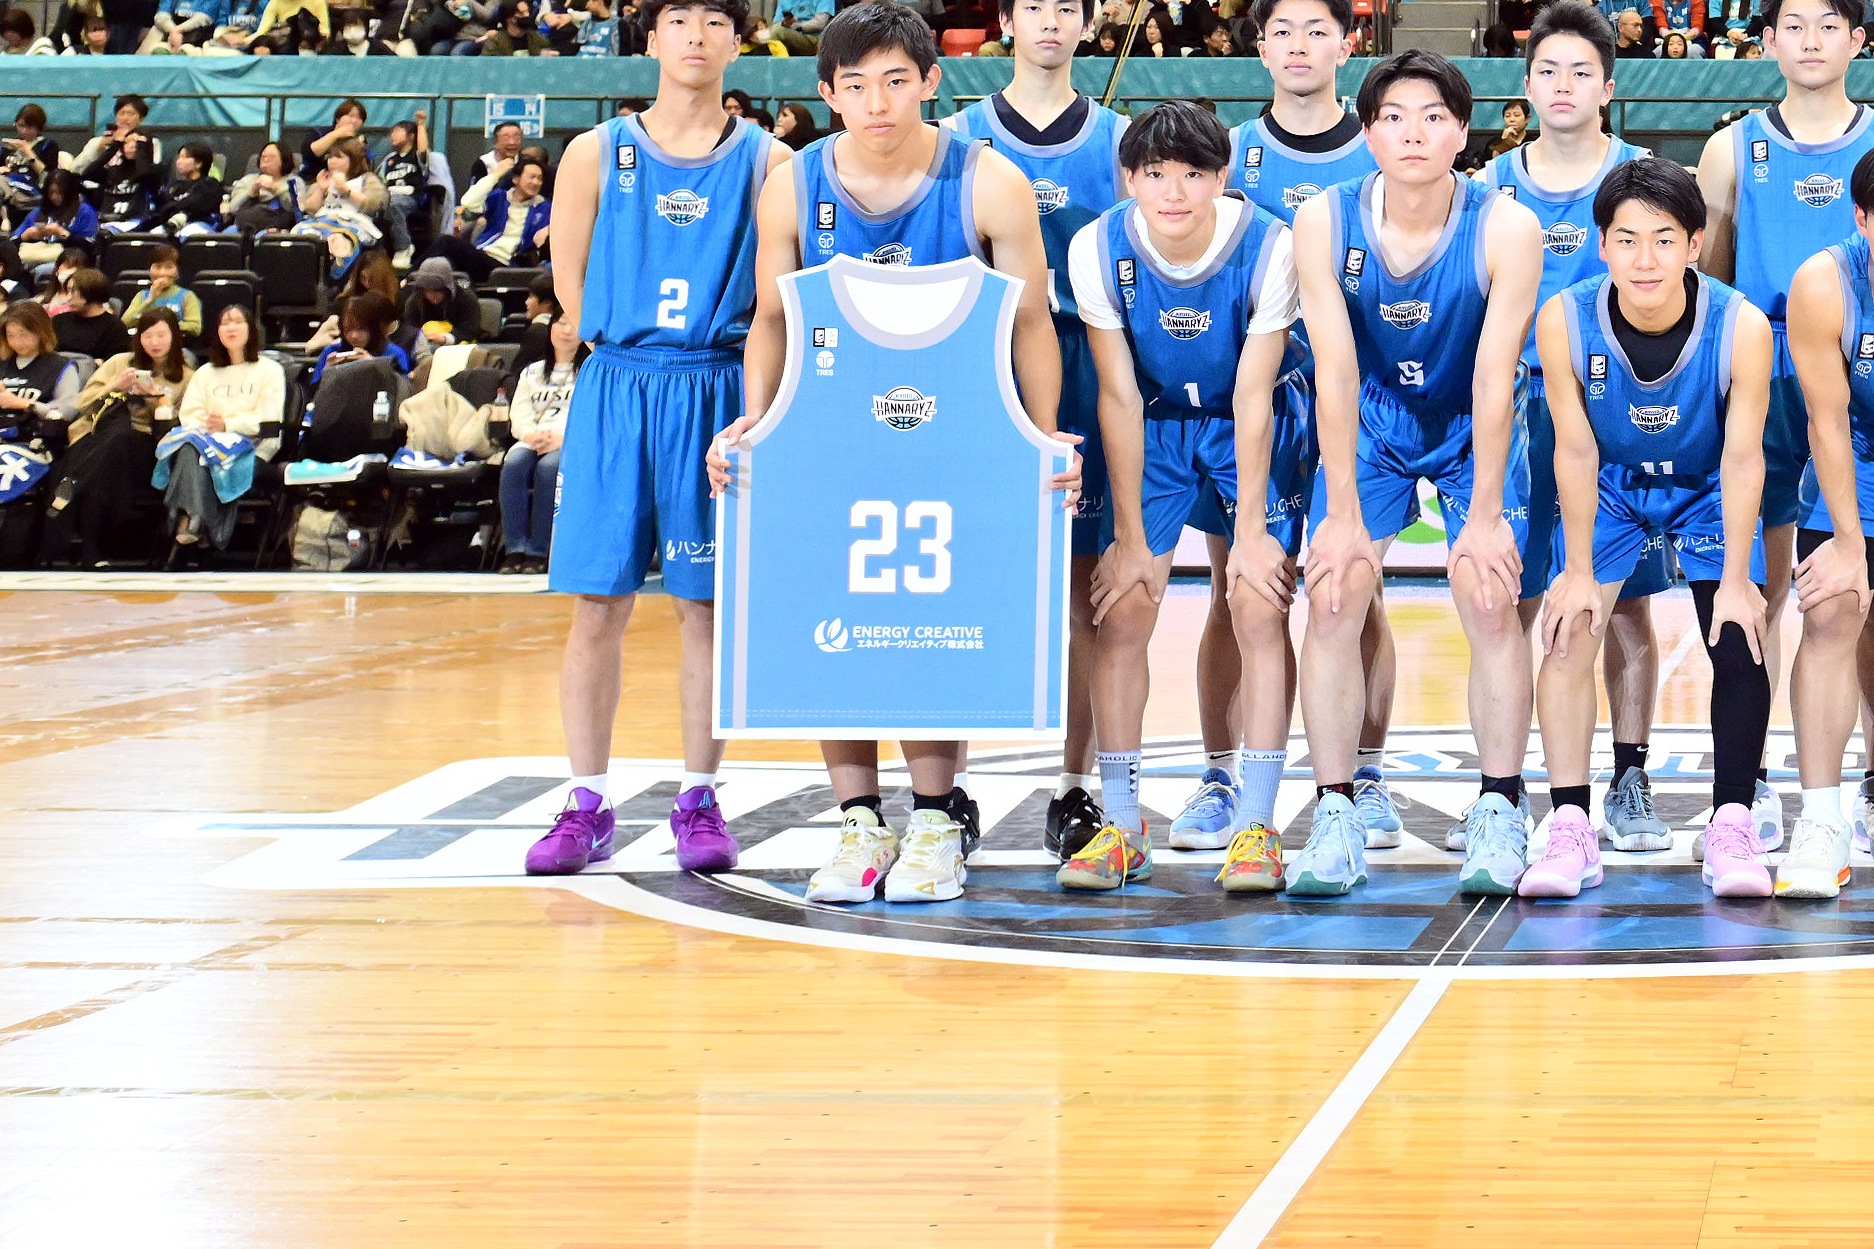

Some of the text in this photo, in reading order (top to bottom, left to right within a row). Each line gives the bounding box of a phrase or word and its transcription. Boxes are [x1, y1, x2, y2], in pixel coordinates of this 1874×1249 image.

[1793, 182, 1844, 198] HANNARYZ
[656, 197, 709, 216] HANNARYZ
[656, 278, 690, 329] 2
[1379, 302, 1432, 321] HANNARYZ
[1158, 311, 1213, 331] HANNARYZ
[872, 400, 936, 418] HANNARYZ
[1629, 407, 1681, 425] HANNARYZ
[1078, 495, 1104, 512] ナリ
[848, 499, 952, 593] 23
[853, 625, 984, 639] ENERGY CREATIVE
[856, 638, 985, 650] エネルギークリエイティブ株式会社
